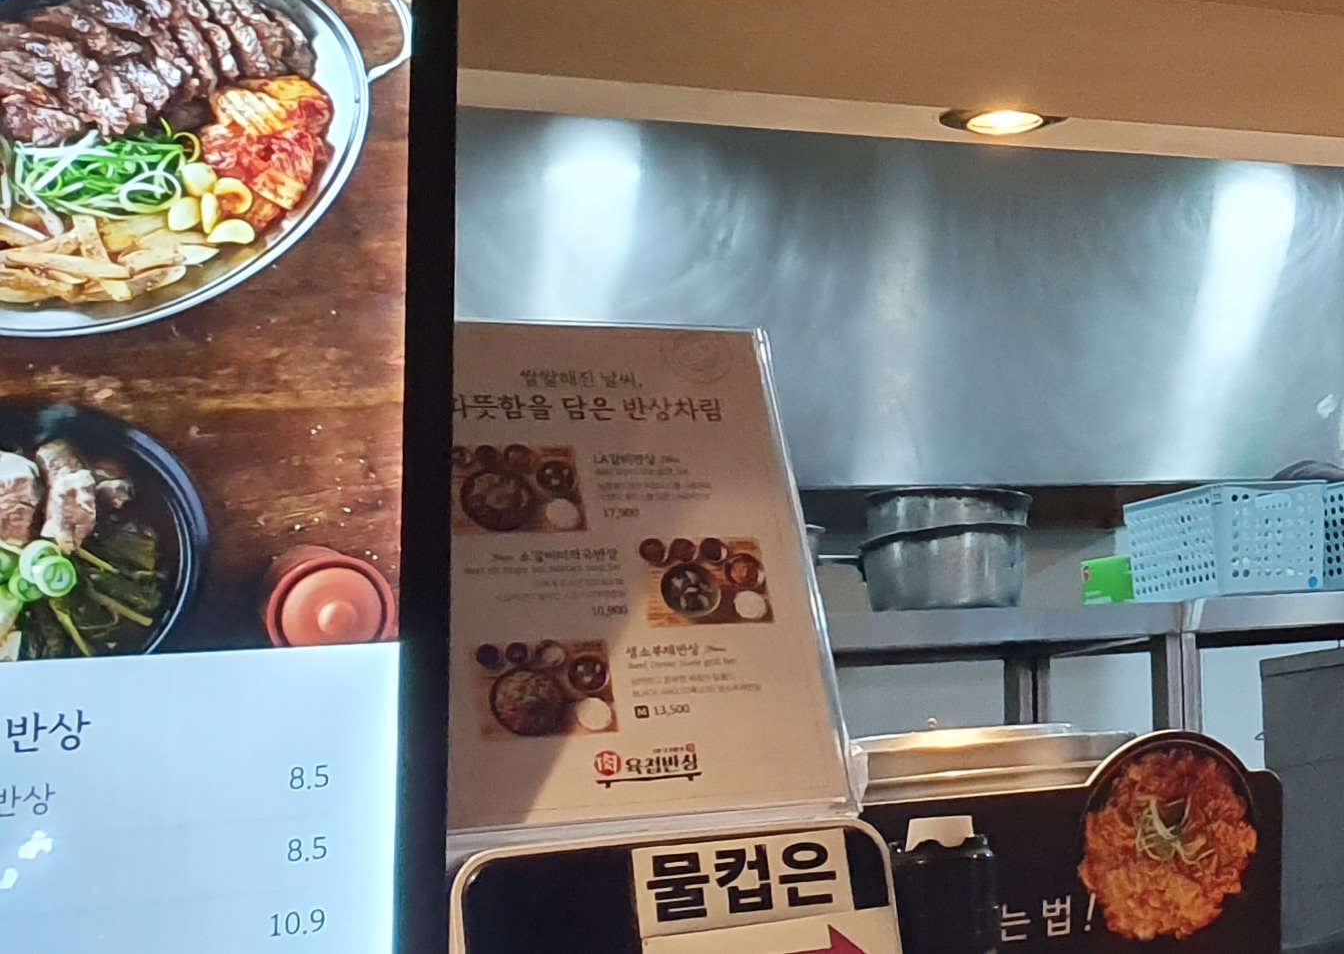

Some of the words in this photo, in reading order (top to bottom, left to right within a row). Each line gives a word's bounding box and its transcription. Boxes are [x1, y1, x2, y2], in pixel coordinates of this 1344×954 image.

[561, 395, 615, 422] 담은
[622, 397, 723, 423] 반상차림
[653, 703, 691, 717] 13,500
[6, 709, 91, 753] 반상
[289, 764, 329, 790] 8.5
[287, 836, 328, 862] 8.5
[646, 840, 836, 922] 물컵은
[270, 909, 326, 937] 10.9
[1000, 903, 1032, 942] 는
